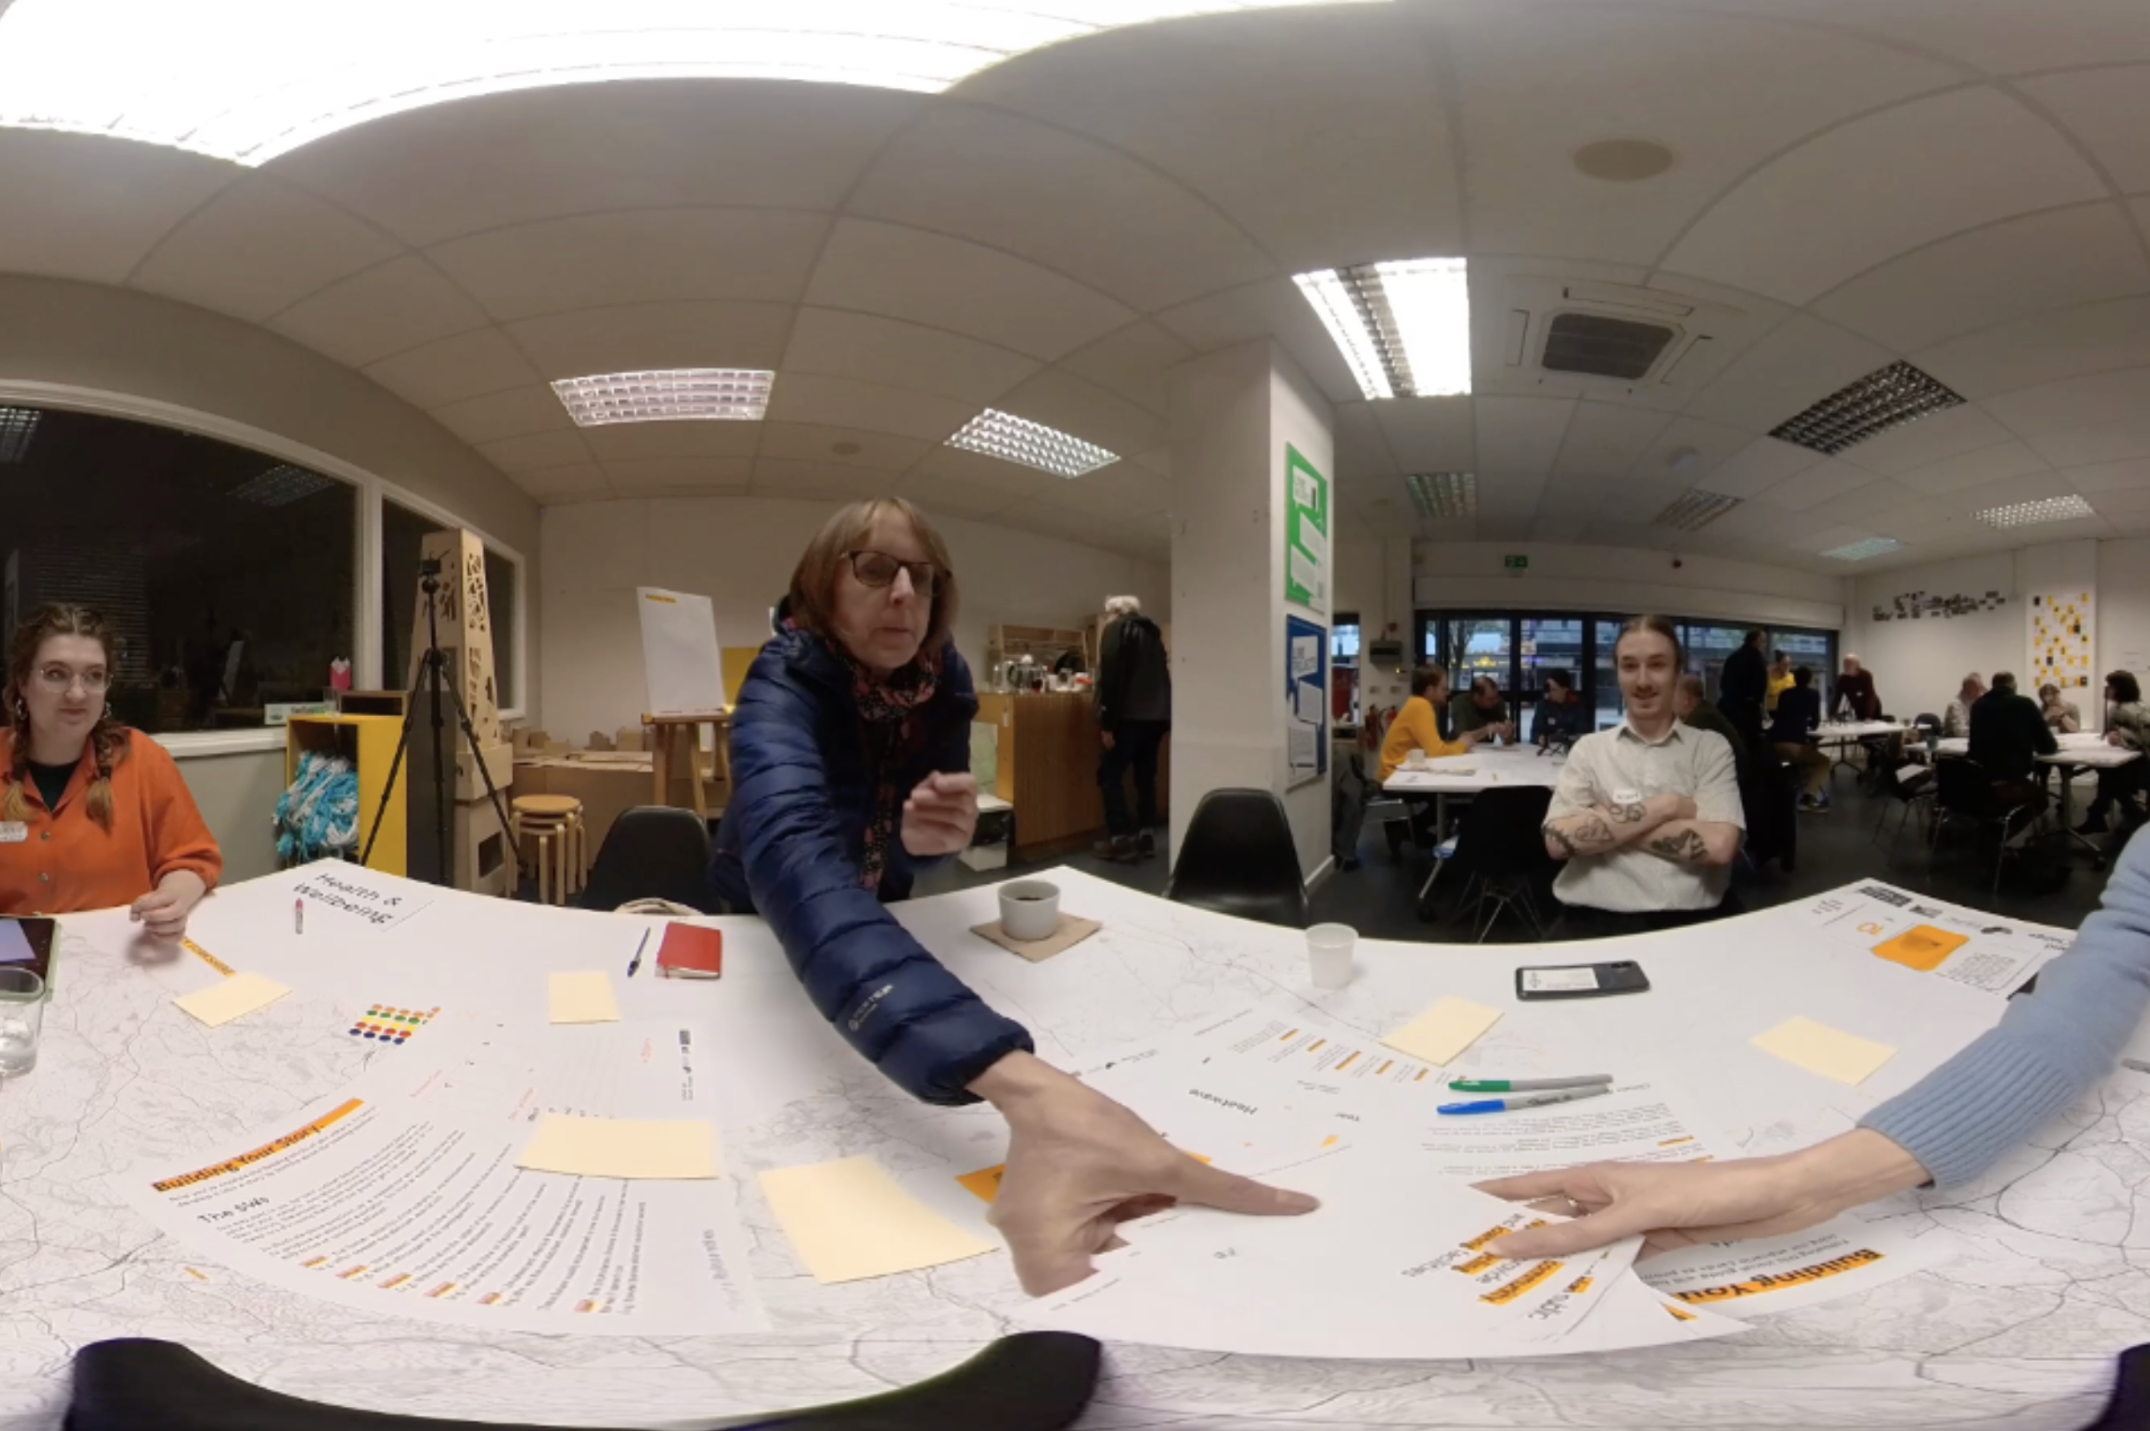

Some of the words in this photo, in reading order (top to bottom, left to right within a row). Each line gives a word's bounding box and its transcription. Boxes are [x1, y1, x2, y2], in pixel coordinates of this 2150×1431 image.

[293, 882, 394, 924] Wellbeing
[315, 873, 380, 901] Health
[151, 1163, 240, 1192] Building
[236, 1145, 275, 1165] Your
[197, 1207, 234, 1225] The
[1751, 1248, 1882, 1288] Building
